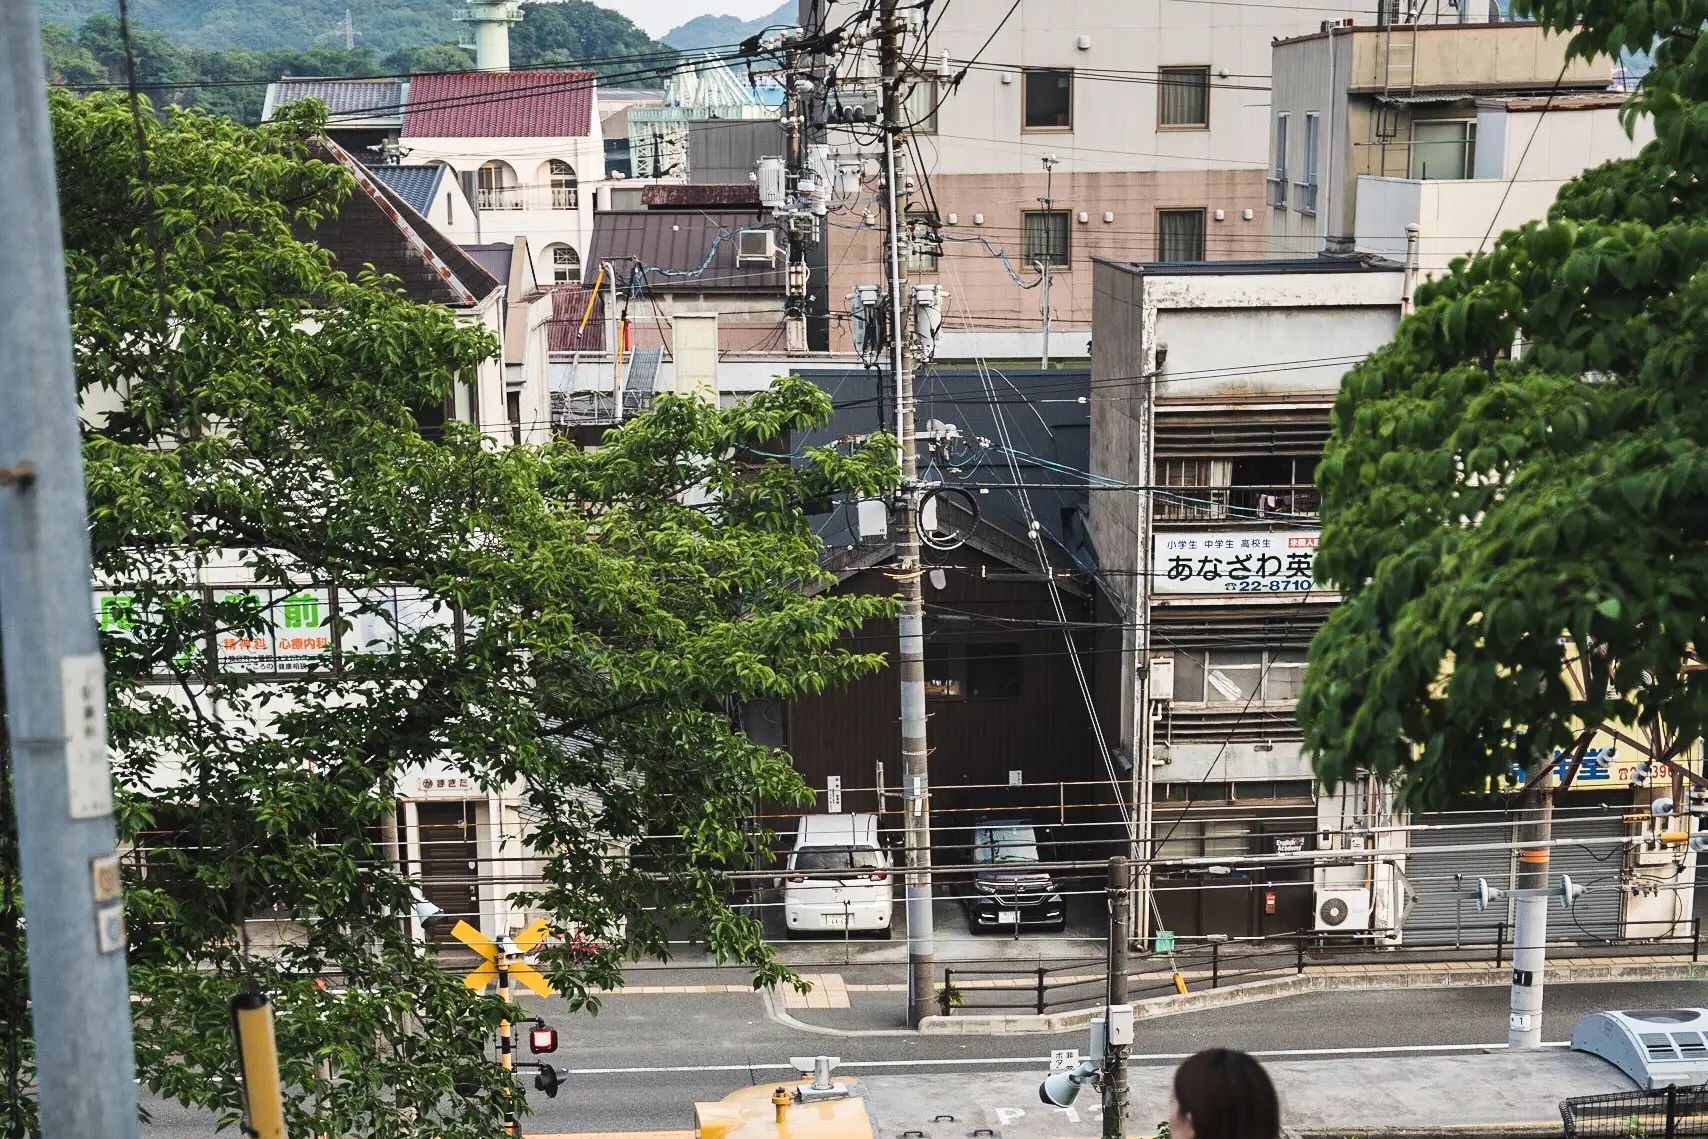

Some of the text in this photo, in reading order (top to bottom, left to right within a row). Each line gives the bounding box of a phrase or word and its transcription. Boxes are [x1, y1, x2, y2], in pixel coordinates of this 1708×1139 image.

[1166, 539, 1198, 550] 小学生
[1204, 539, 1235, 549] 中学生
[1240, 538, 1271, 549] 高校生
[1239, 579, 1312, 592] 22-8710
[223, 637, 329, 651] 精神科 心療内科
